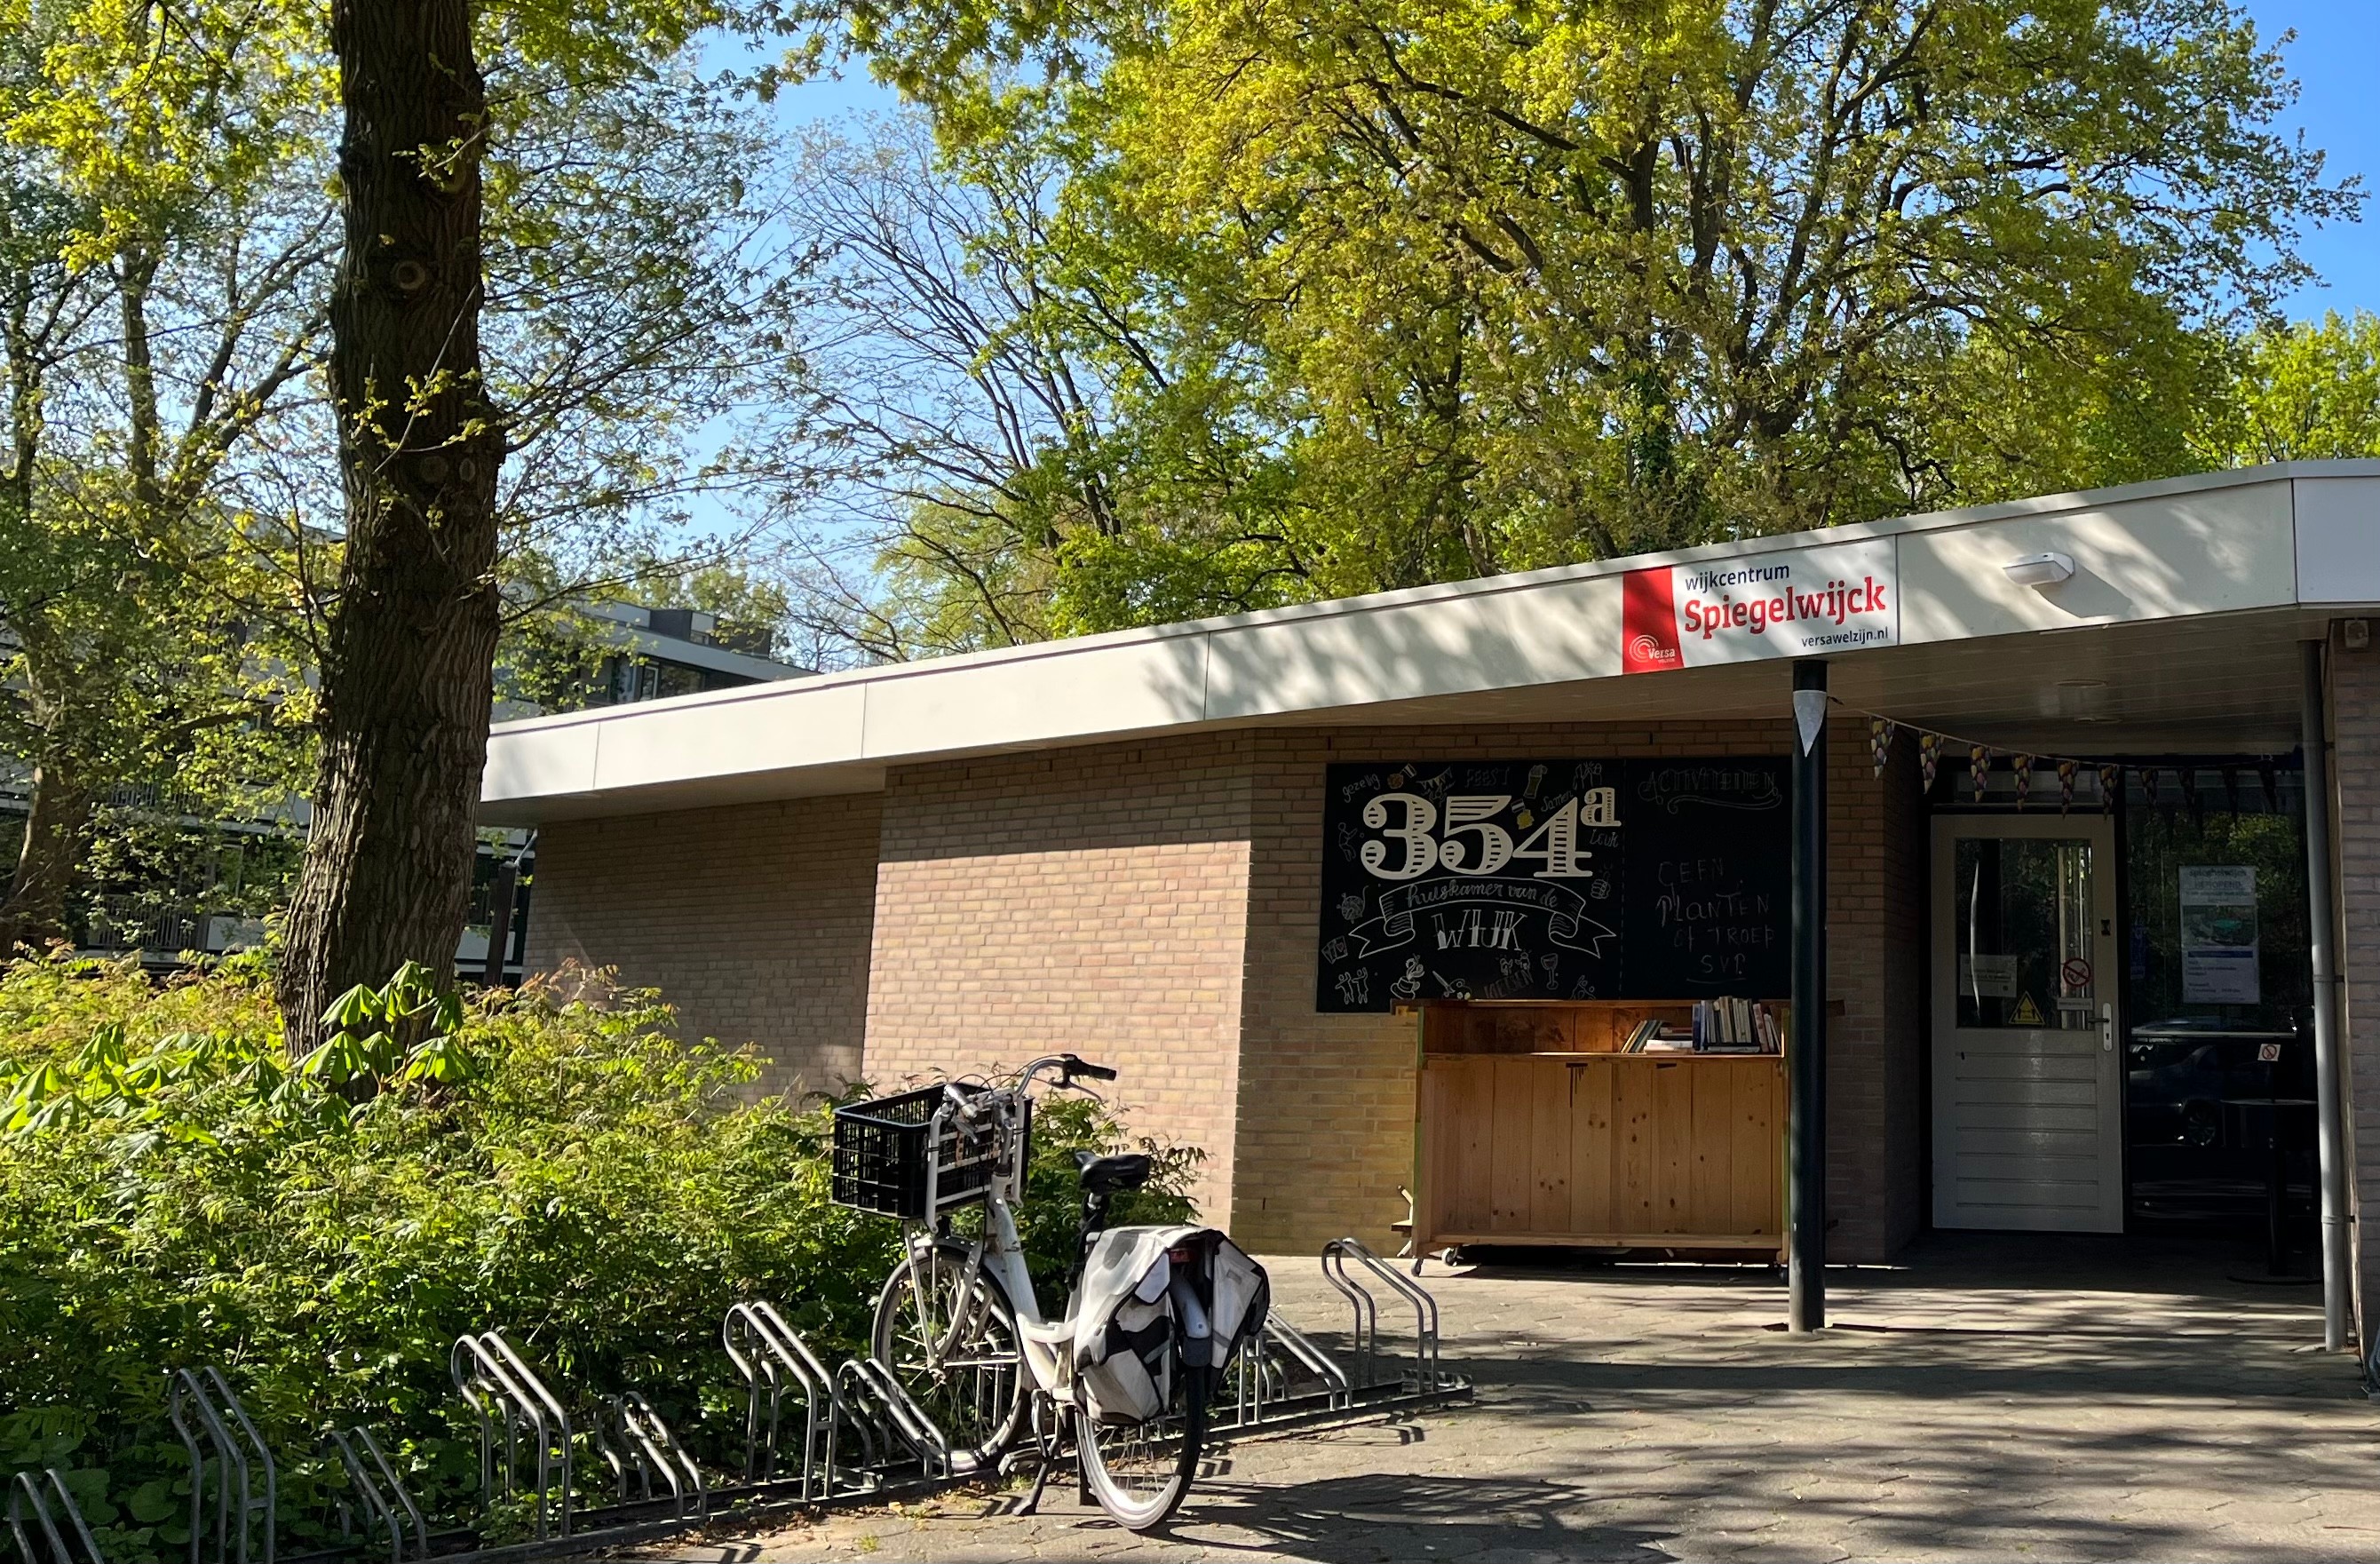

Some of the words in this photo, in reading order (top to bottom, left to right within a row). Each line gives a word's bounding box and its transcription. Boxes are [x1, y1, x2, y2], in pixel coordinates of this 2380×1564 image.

[1685, 565, 1790, 594] wijkcentrum
[1685, 576, 1886, 639] Spiegelwijck
[1801, 627, 1889, 647] versawelzijn.nl
[1647, 647, 1676, 660] Versa
[1342, 773, 1381, 803] gezellig
[1465, 766, 1510, 788] FEEST
[1658, 858, 1725, 889] GEEN
[1508, 884, 1538, 901] van
[1539, 887, 1559, 908] de
[1431, 909, 1529, 951] WIJK
[1706, 925, 1775, 949] TROEP
